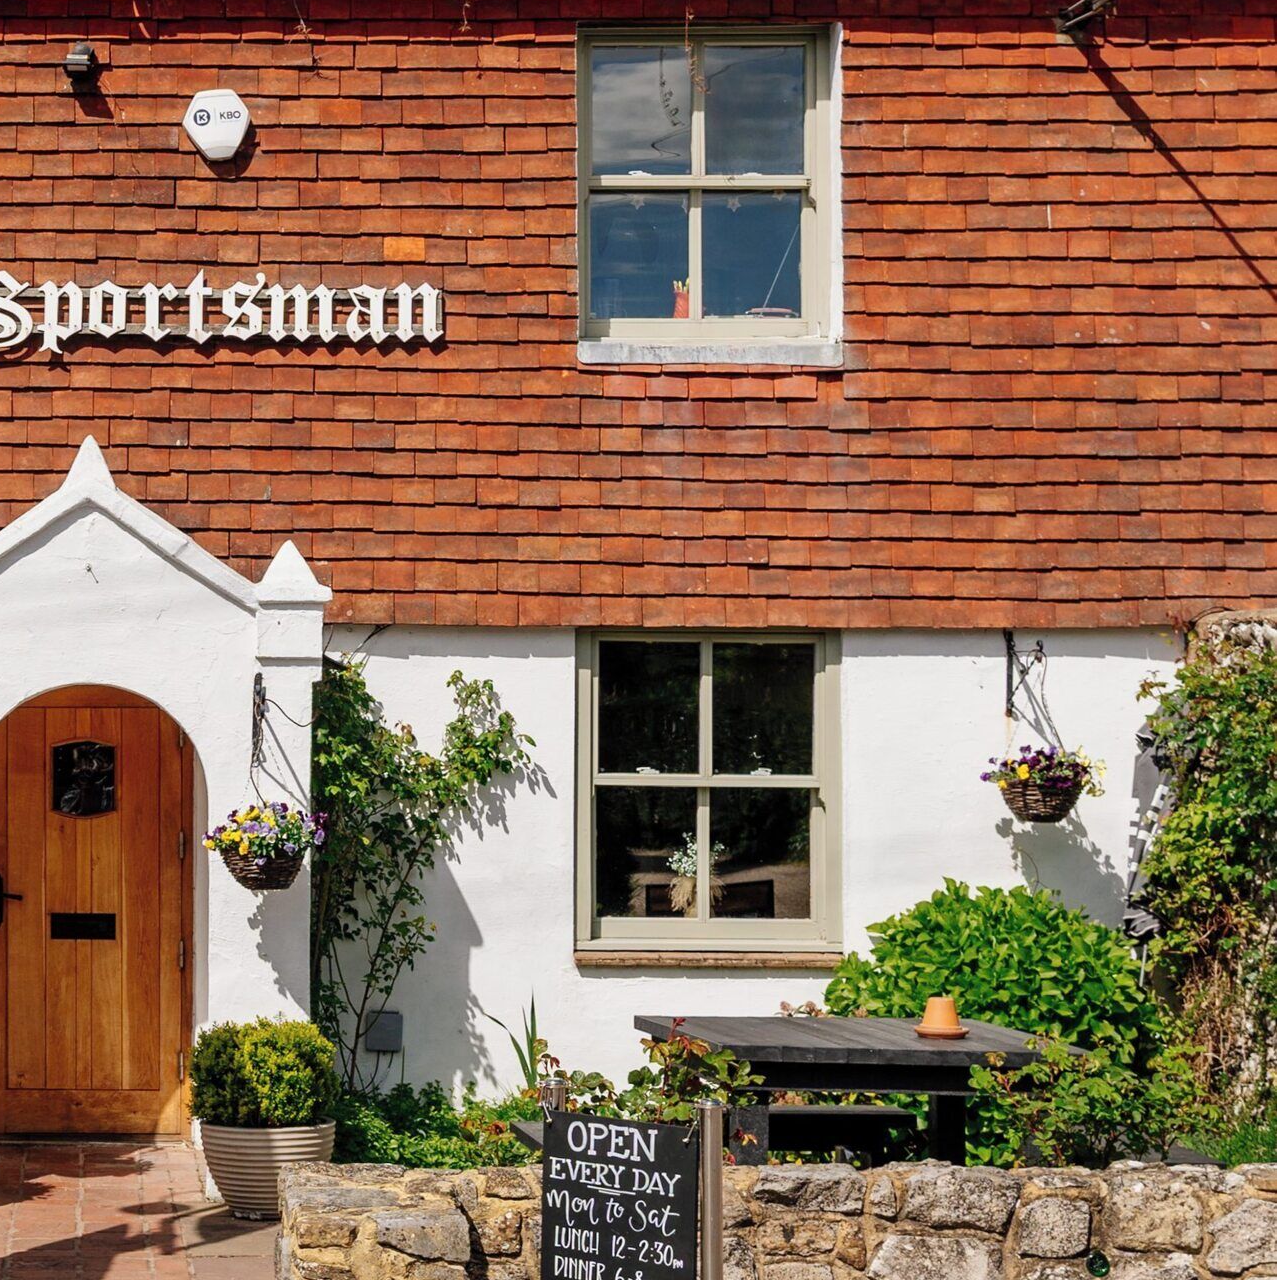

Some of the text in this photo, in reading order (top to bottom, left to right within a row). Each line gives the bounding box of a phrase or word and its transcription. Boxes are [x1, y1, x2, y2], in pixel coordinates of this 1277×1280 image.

[219, 110, 241, 120] KBO
[567, 1121, 659, 1162] OPEN
[549, 1156, 682, 1197] EVERY DAY
[546, 1189, 681, 1237] Mon to Sat
[554, 1225, 600, 1255] LUNCH
